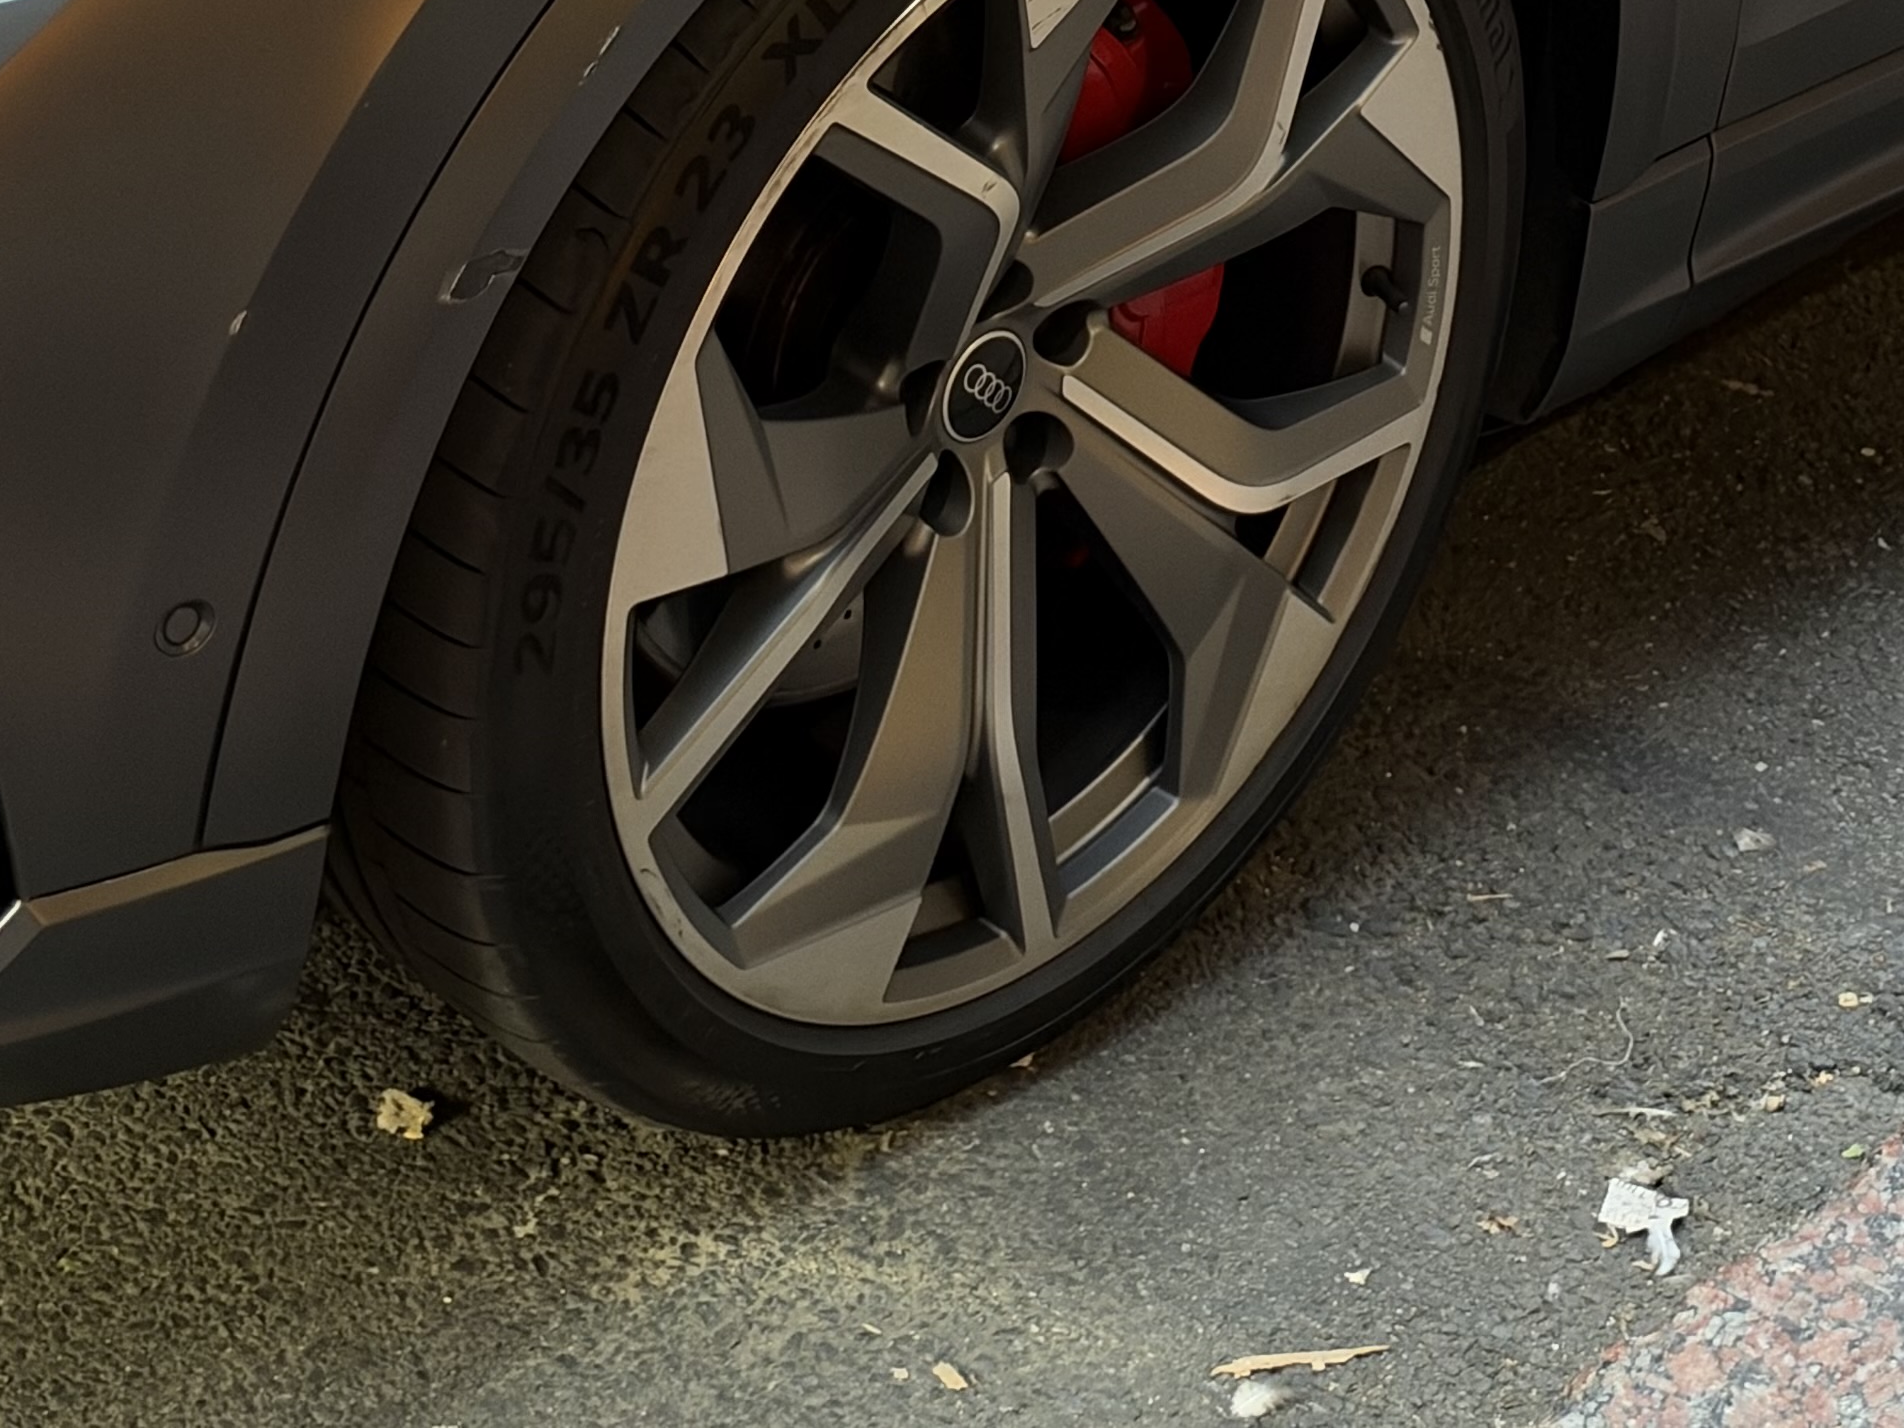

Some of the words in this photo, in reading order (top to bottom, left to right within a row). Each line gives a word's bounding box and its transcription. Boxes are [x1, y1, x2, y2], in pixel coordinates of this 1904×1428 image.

[1427, 245, 1441, 287] Sport
[1422, 290, 1437, 326] Audi
[511, 366, 622, 677] 295/35
[603, 222, 686, 348] ZR
[675, 102, 758, 216] 23
